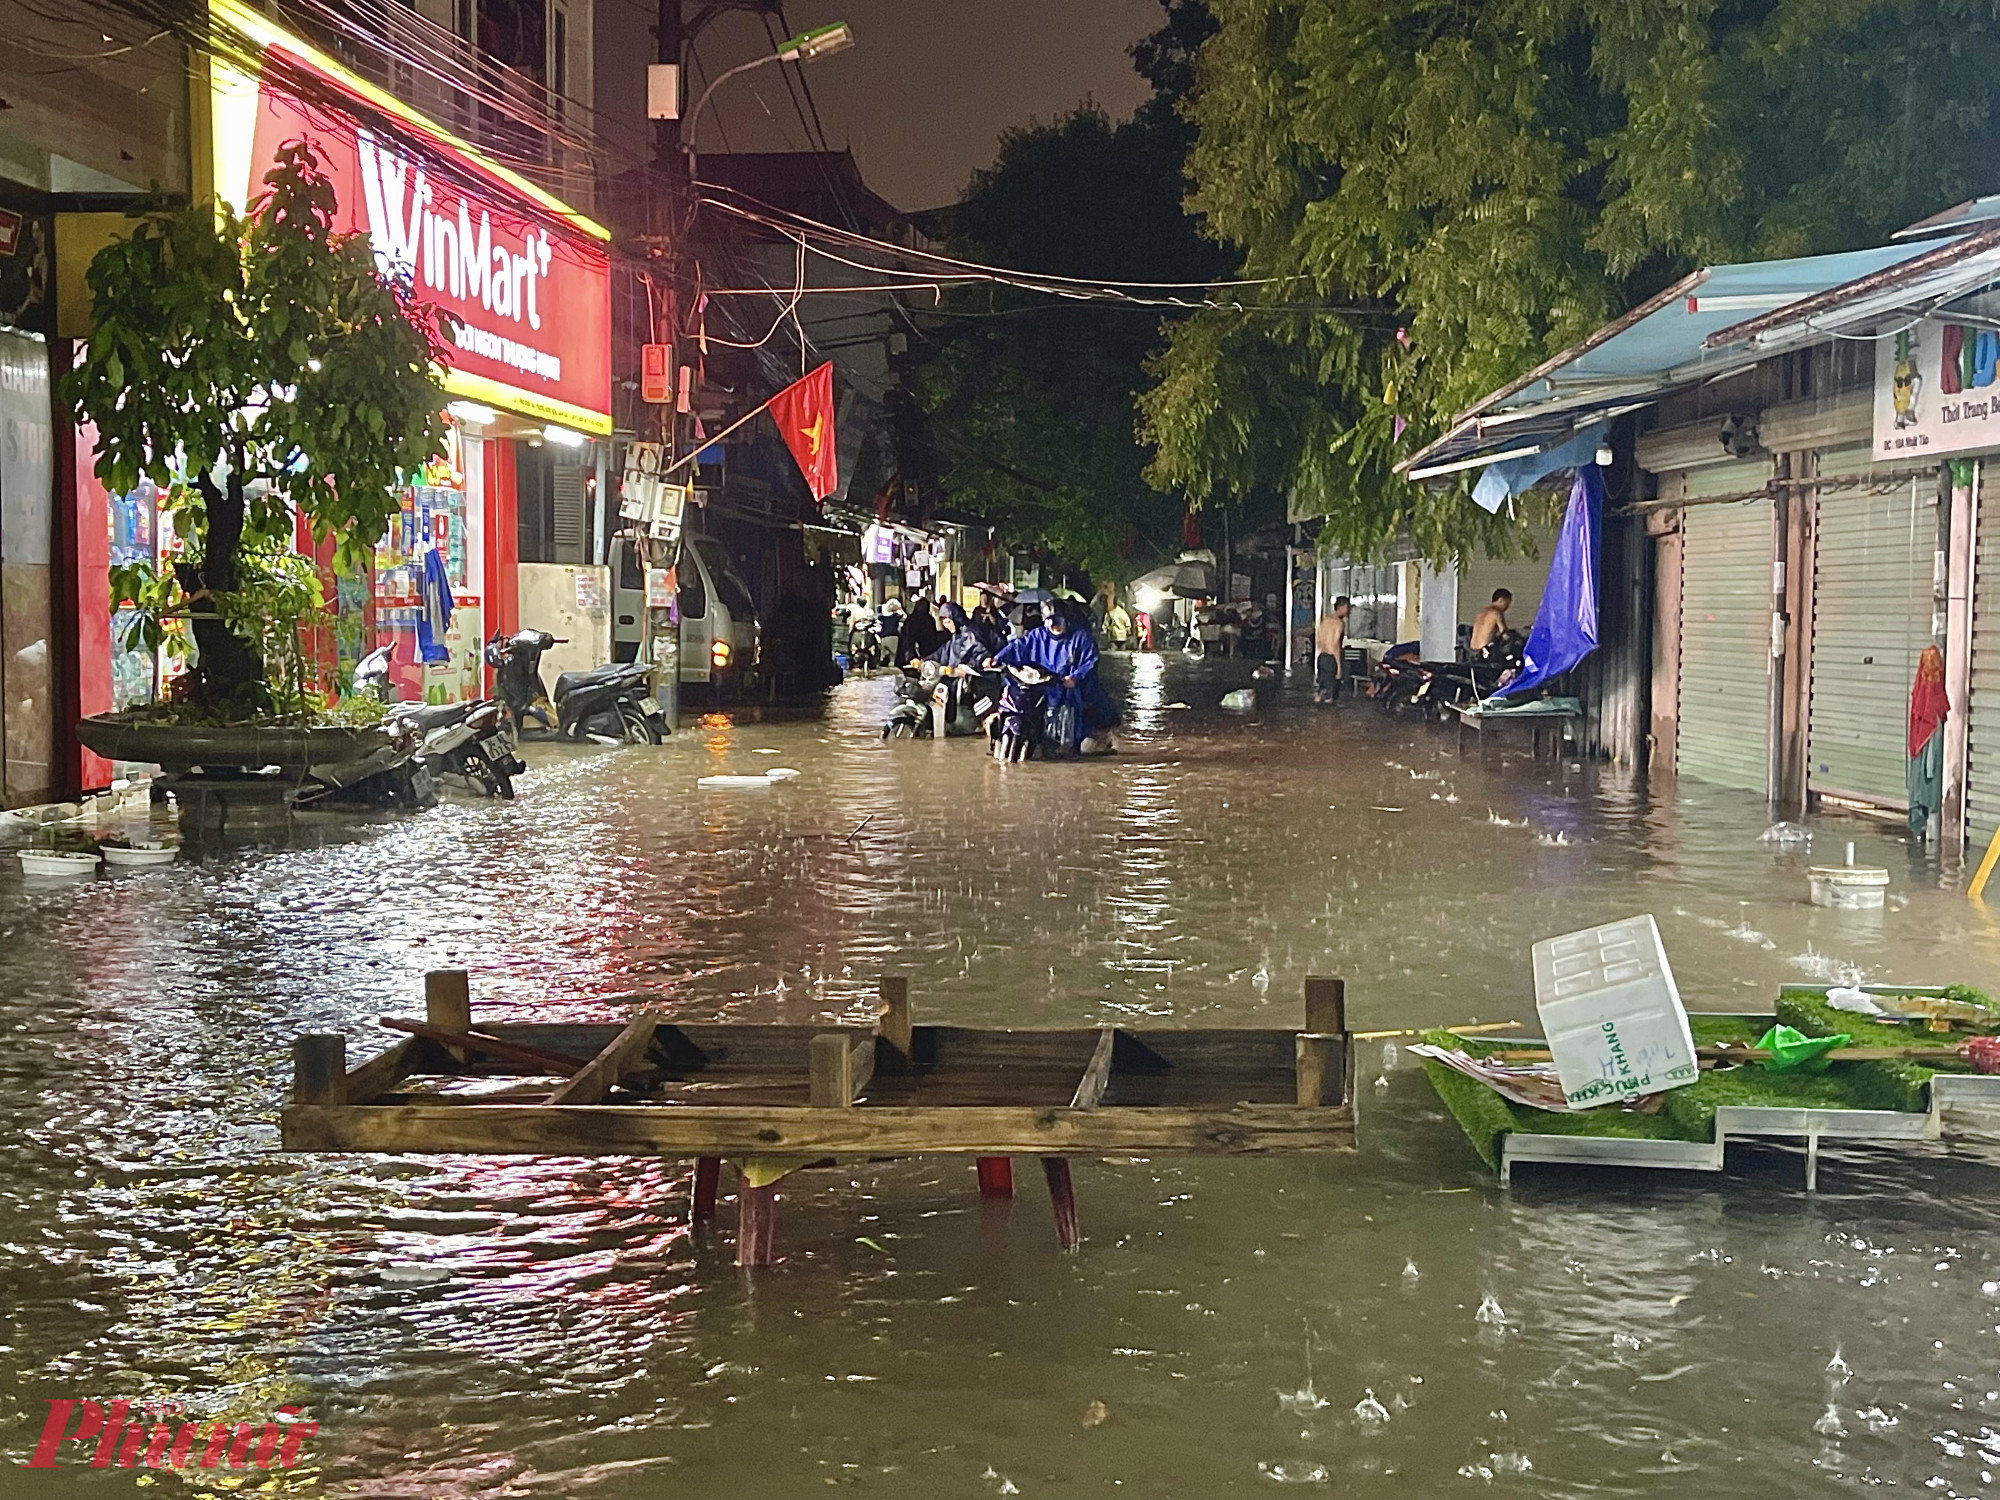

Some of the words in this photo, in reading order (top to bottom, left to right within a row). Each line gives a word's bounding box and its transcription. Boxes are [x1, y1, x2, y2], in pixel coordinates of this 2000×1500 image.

[1963, 402, 1988, 420] Trang
[7, 419, 49, 465] STOP
[1601, 1021, 1632, 1076] KHANG
